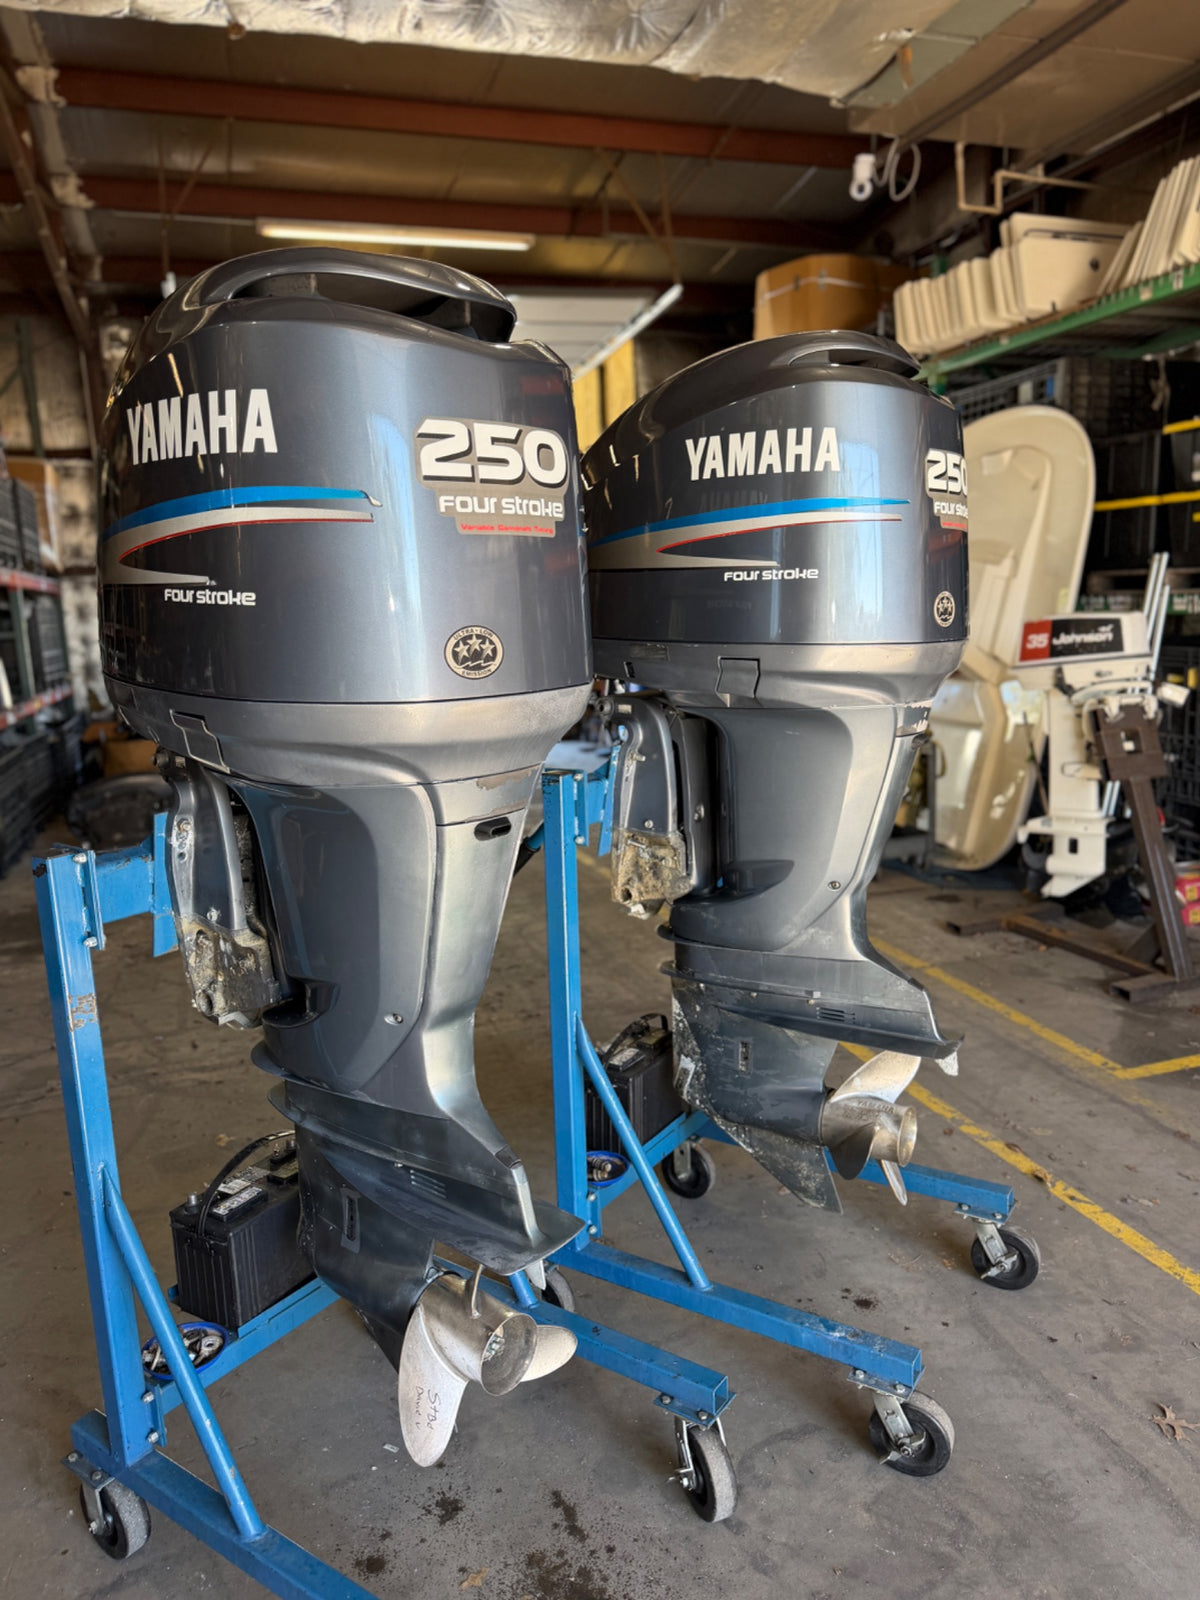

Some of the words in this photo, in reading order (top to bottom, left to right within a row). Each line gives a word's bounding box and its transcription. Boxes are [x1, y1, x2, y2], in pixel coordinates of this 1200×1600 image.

[126, 388, 278, 466] YAMAHA
[417, 418, 568, 489] 250
[684, 427, 841, 481] YAMAHA
[927, 449, 969, 496] 250
[1026, 632, 1050, 649] 35
[1052, 632, 1114, 646] Johnson
